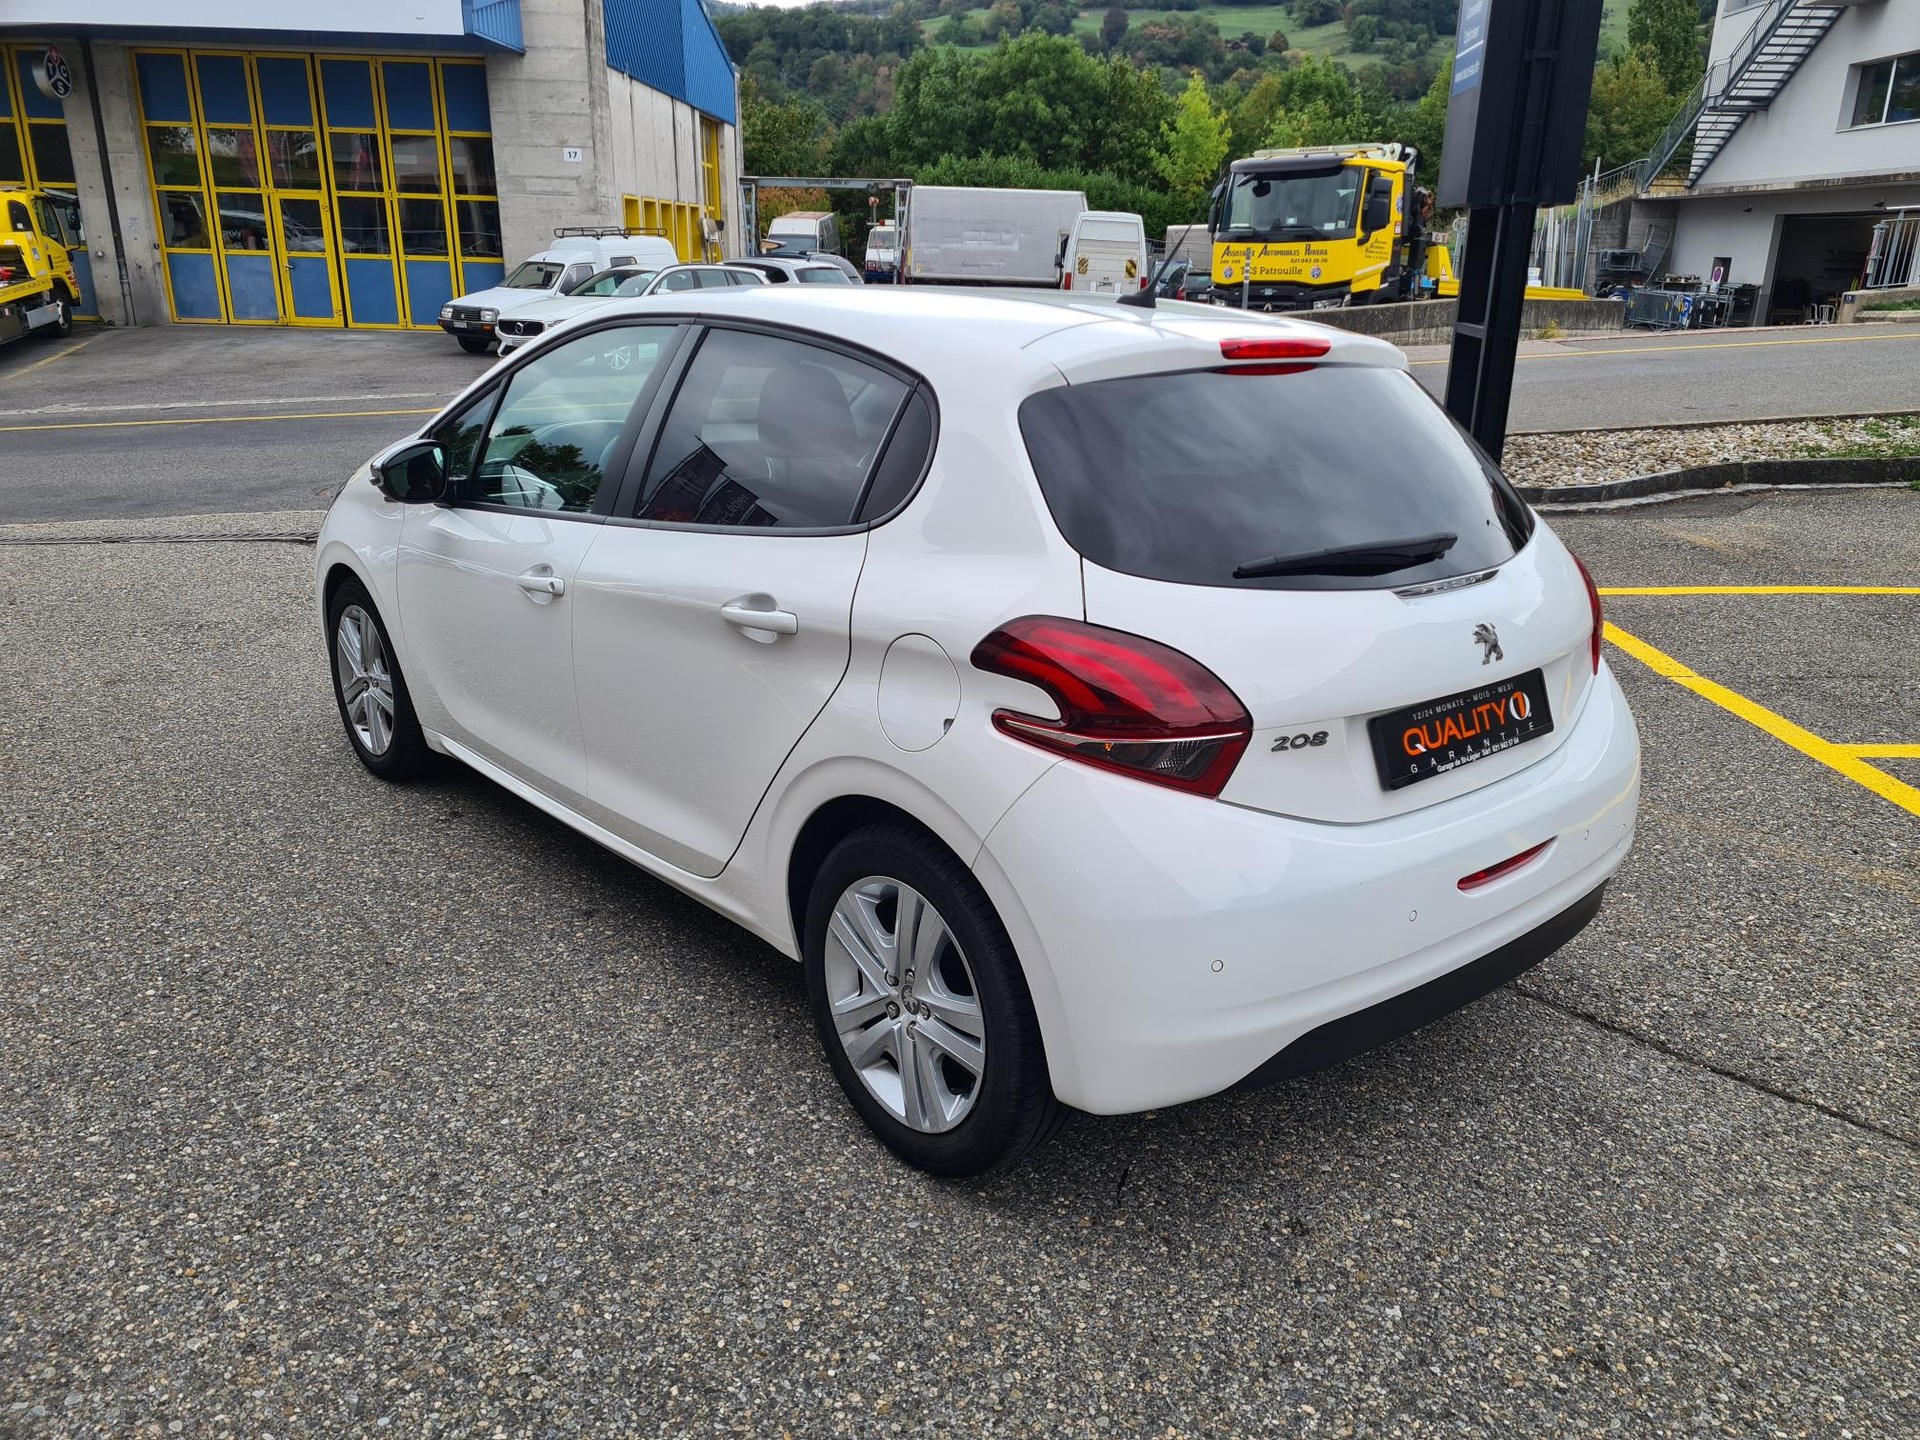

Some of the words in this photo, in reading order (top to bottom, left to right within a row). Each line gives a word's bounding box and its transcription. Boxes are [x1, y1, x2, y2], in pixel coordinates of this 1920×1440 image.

[567, 151, 578, 159] 17
[1221, 244, 1255, 258] ASSISTAE
[1259, 266, 1303, 275] Patrouille
[1412, 708, 1434, 721] 12/24
[1435, 698, 1465, 713] MONATE
[1472, 690, 1491, 701] MOIS
[1497, 682, 1514, 693] MESI
[1403, 697, 1507, 757] QUALITY
[1271, 731, 1330, 752] 208
[1437, 761, 1455, 773] Garage
